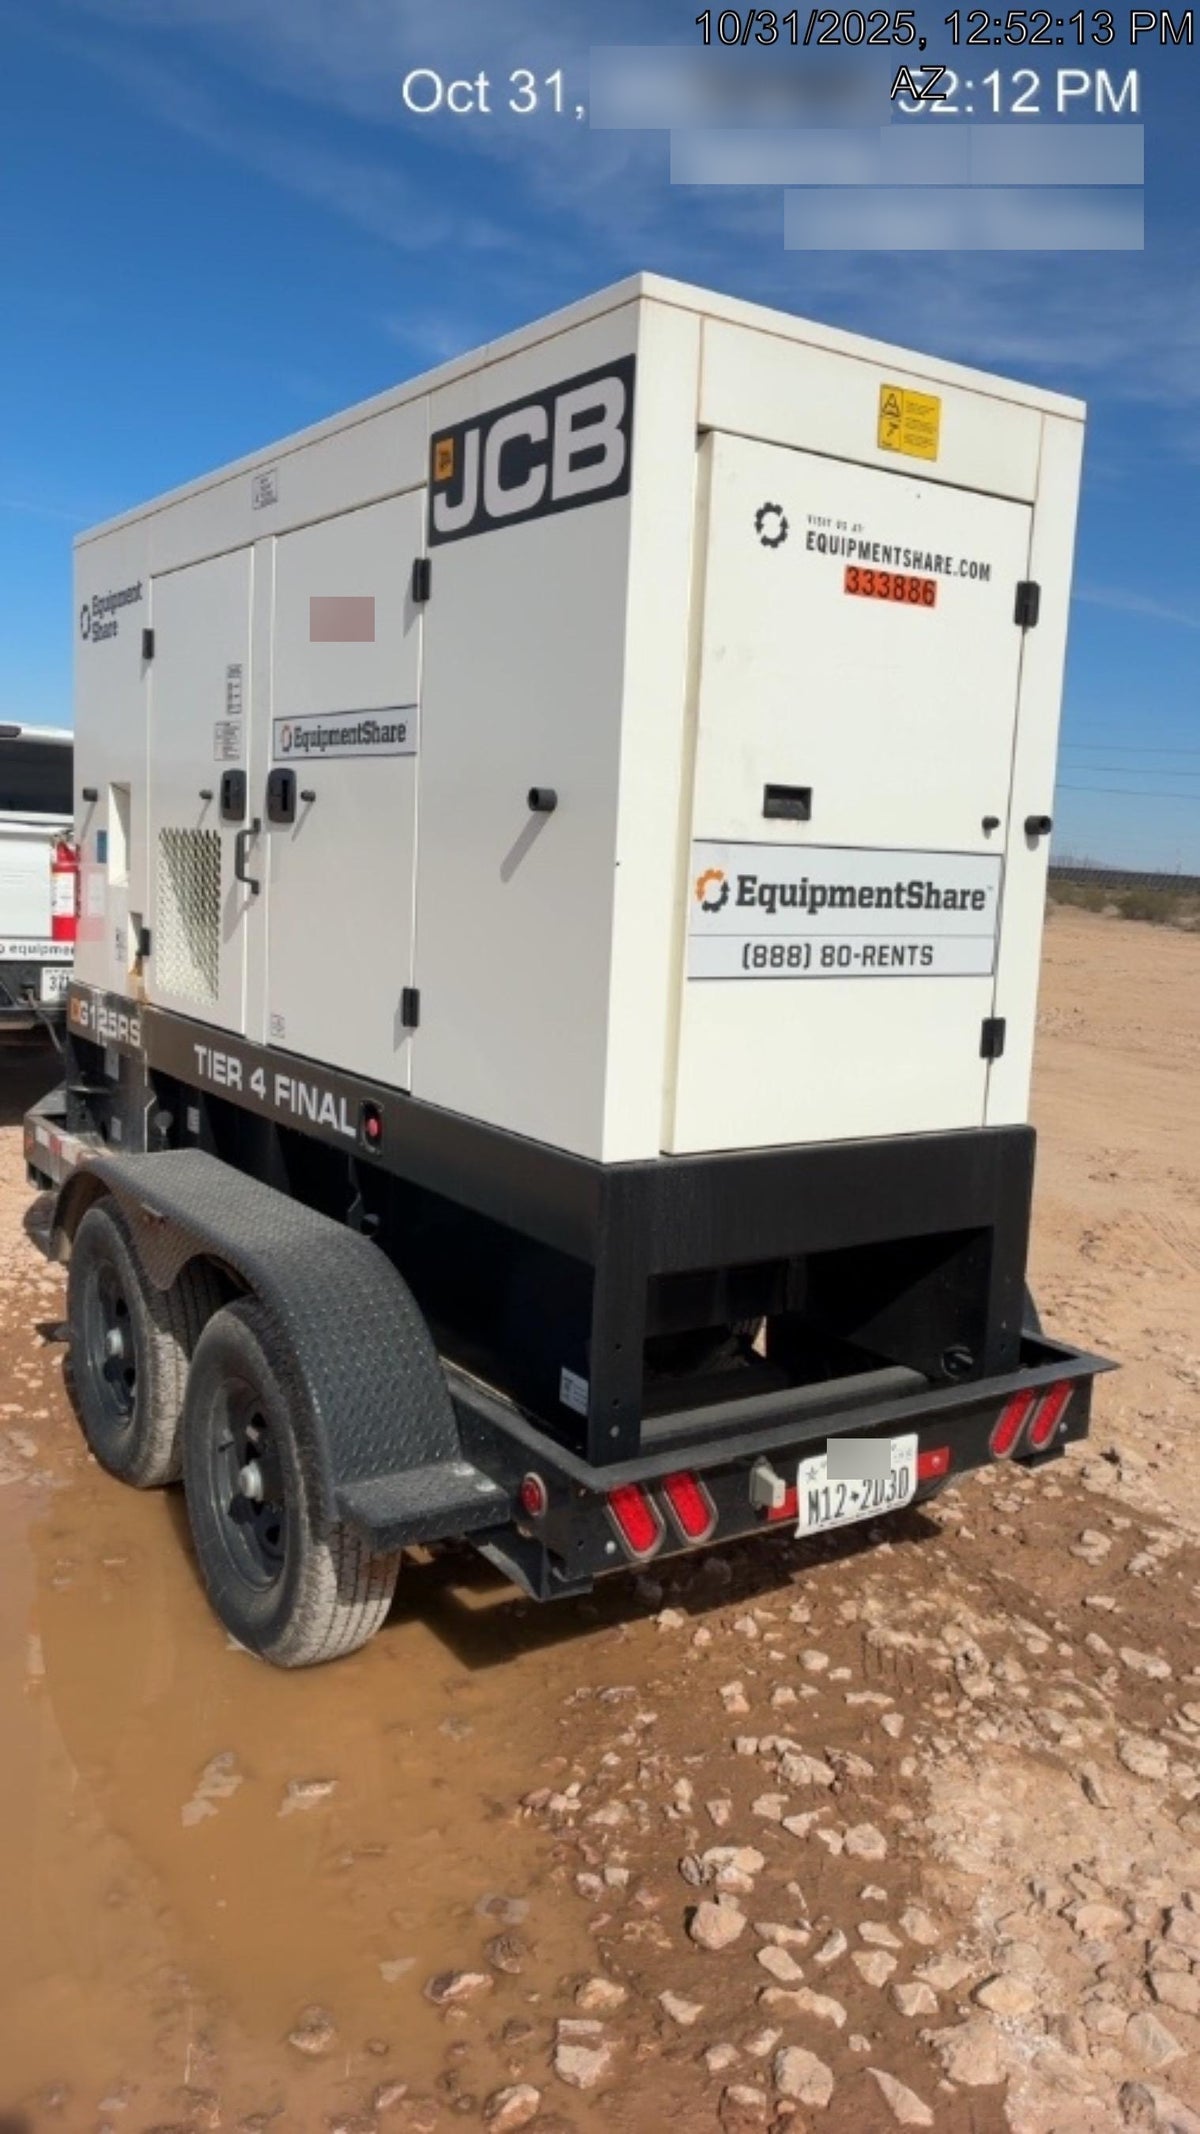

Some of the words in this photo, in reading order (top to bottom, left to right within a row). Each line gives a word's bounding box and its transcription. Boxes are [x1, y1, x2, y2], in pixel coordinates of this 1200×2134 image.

[433, 376, 627, 533] JCB
[805, 530, 991, 582] EQUIPMENTSHARE.COM
[91, 580, 143, 619] Equipment
[845, 566, 937, 607] 333886
[91, 620, 118, 643] Share
[293, 720, 407, 752] EquipmentShare
[735, 874, 986, 915] EquipmentShare
[741, 943, 812, 969] (888)
[820, 944, 934, 968] 80-RENTS
[194, 1043, 243, 1092] TIER
[250, 1066, 267, 1100] 4
[274, 1072, 357, 1138] FINAL
